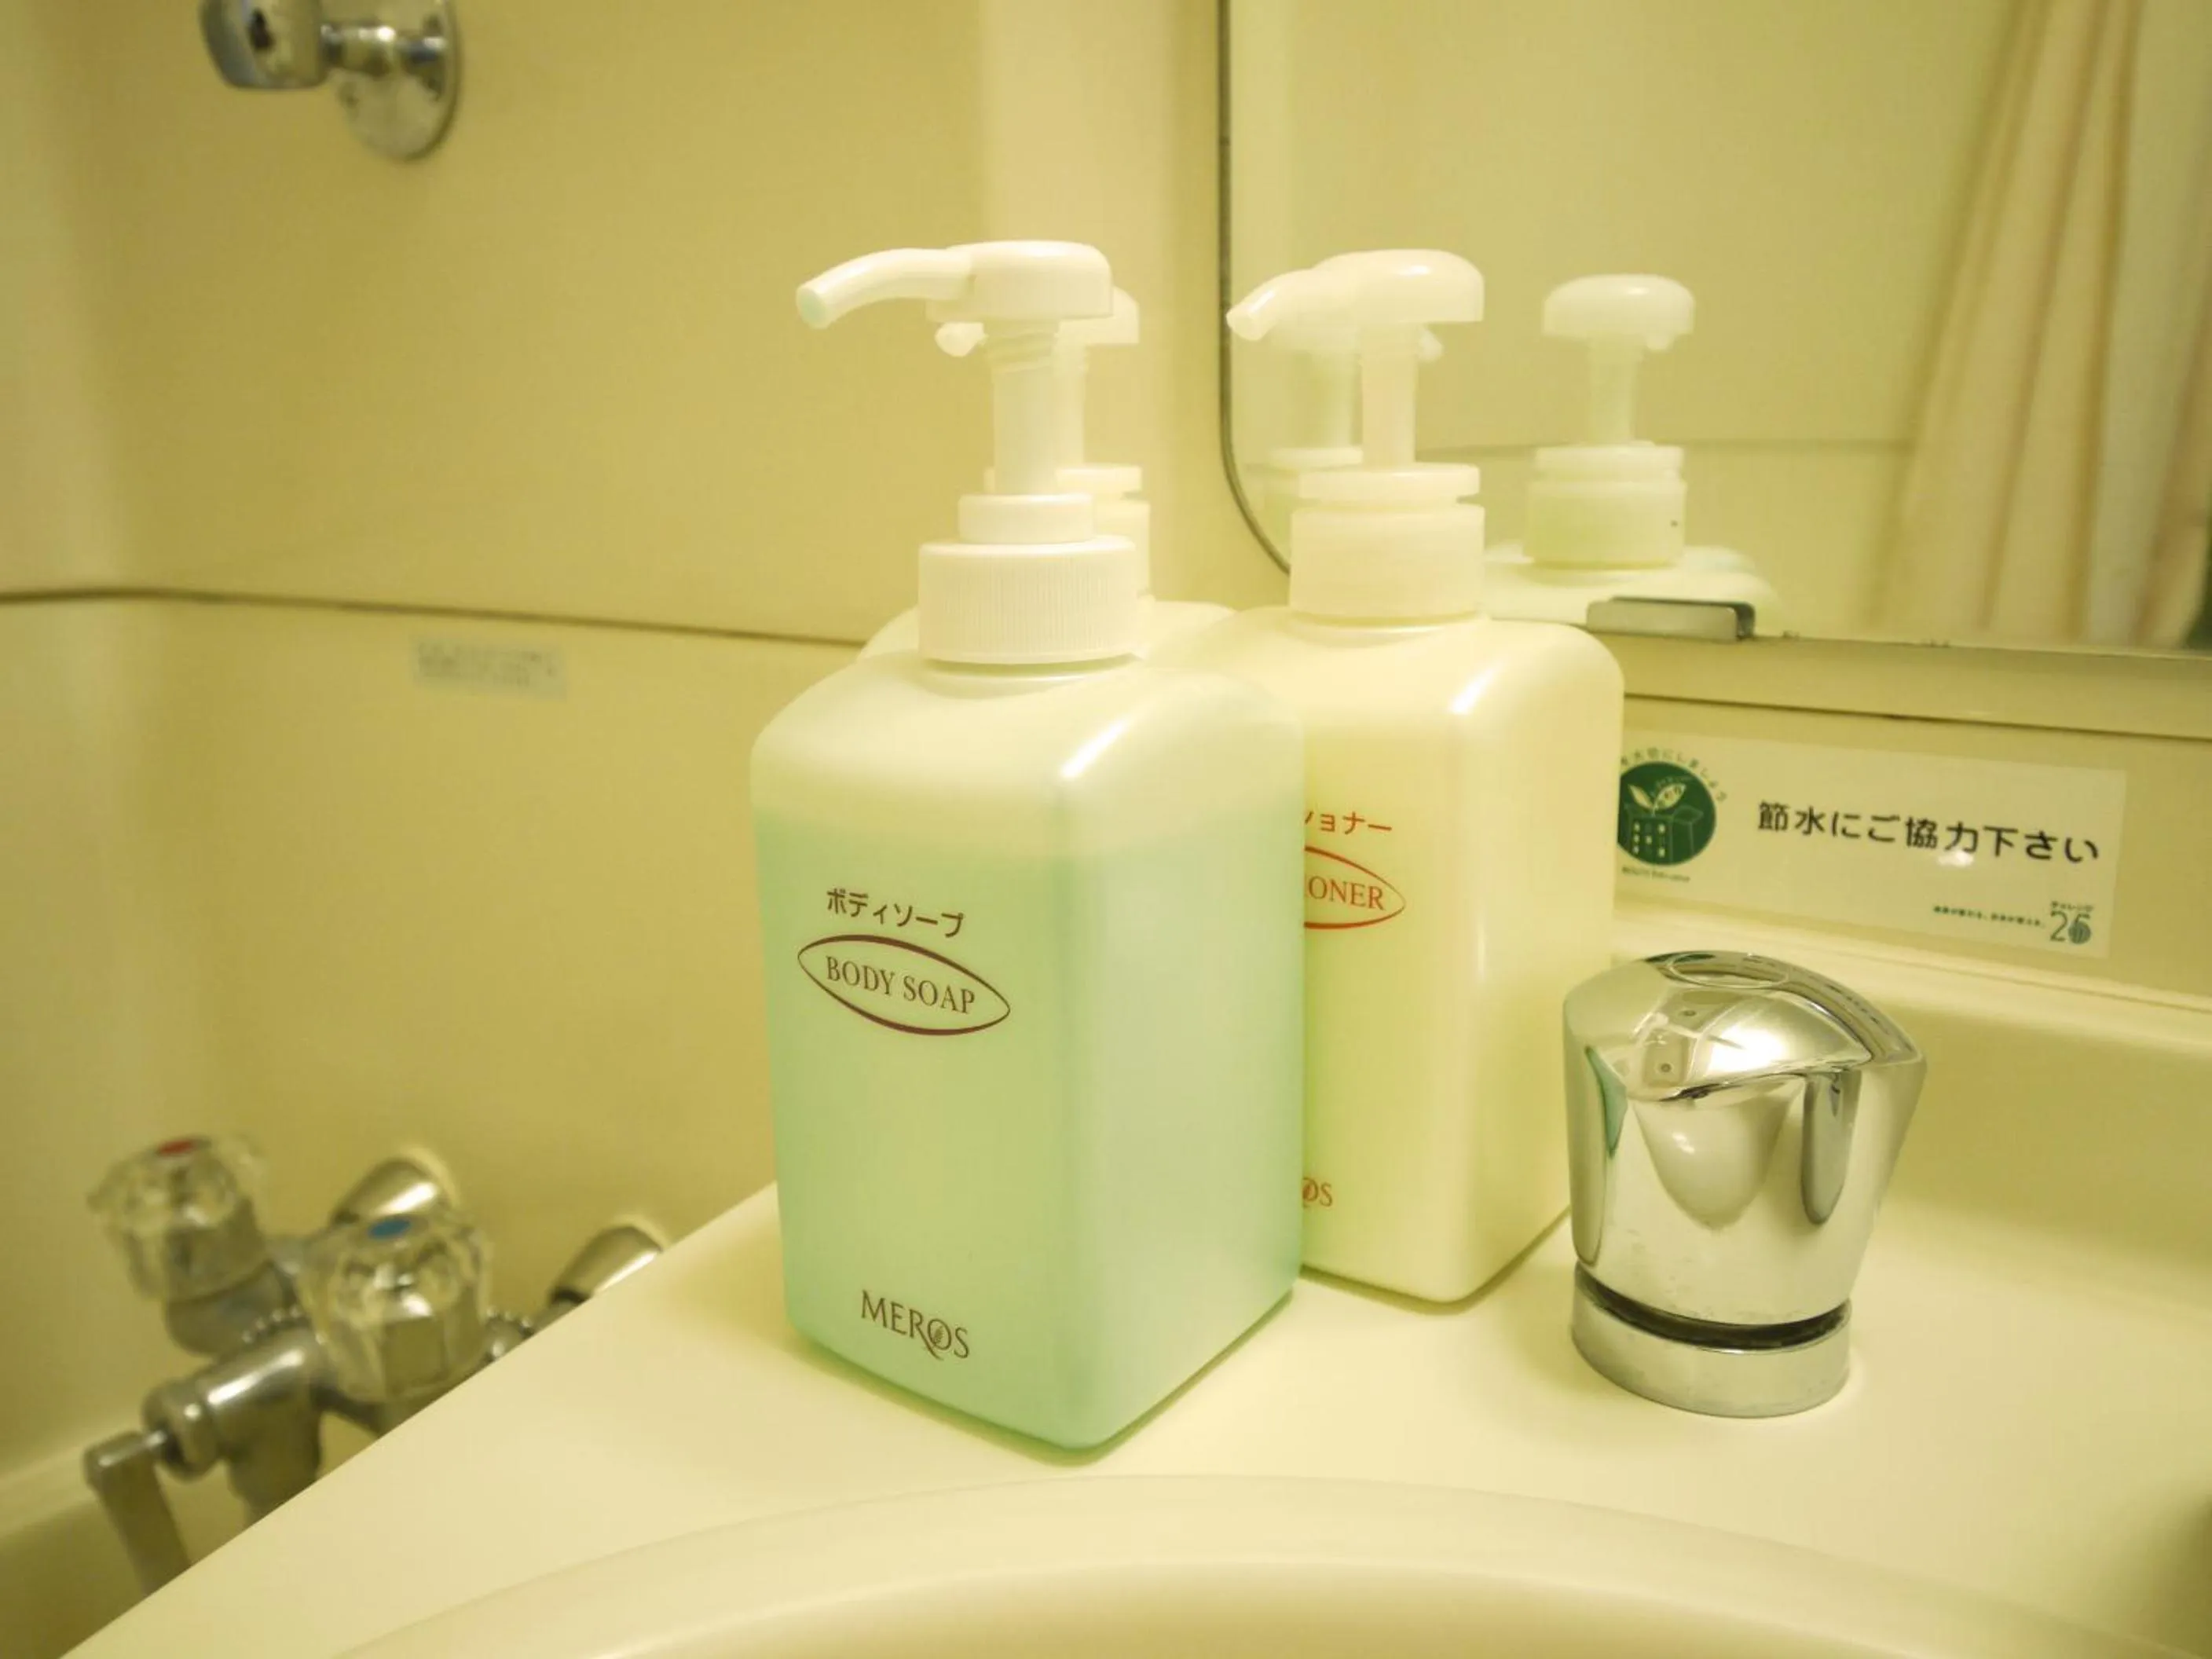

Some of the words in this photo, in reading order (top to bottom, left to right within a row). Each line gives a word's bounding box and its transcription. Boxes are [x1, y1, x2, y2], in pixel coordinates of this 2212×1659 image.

[1758, 800, 2100, 863] 節水にご協力下さい
[827, 888, 964, 938] ボディソープ
[1305, 874, 1385, 911] ONER
[826, 956, 895, 995] BODY
[903, 976, 975, 1014] SOAP
[1302, 1177, 1333, 1208] OS
[861, 1289, 970, 1361] MEROS
